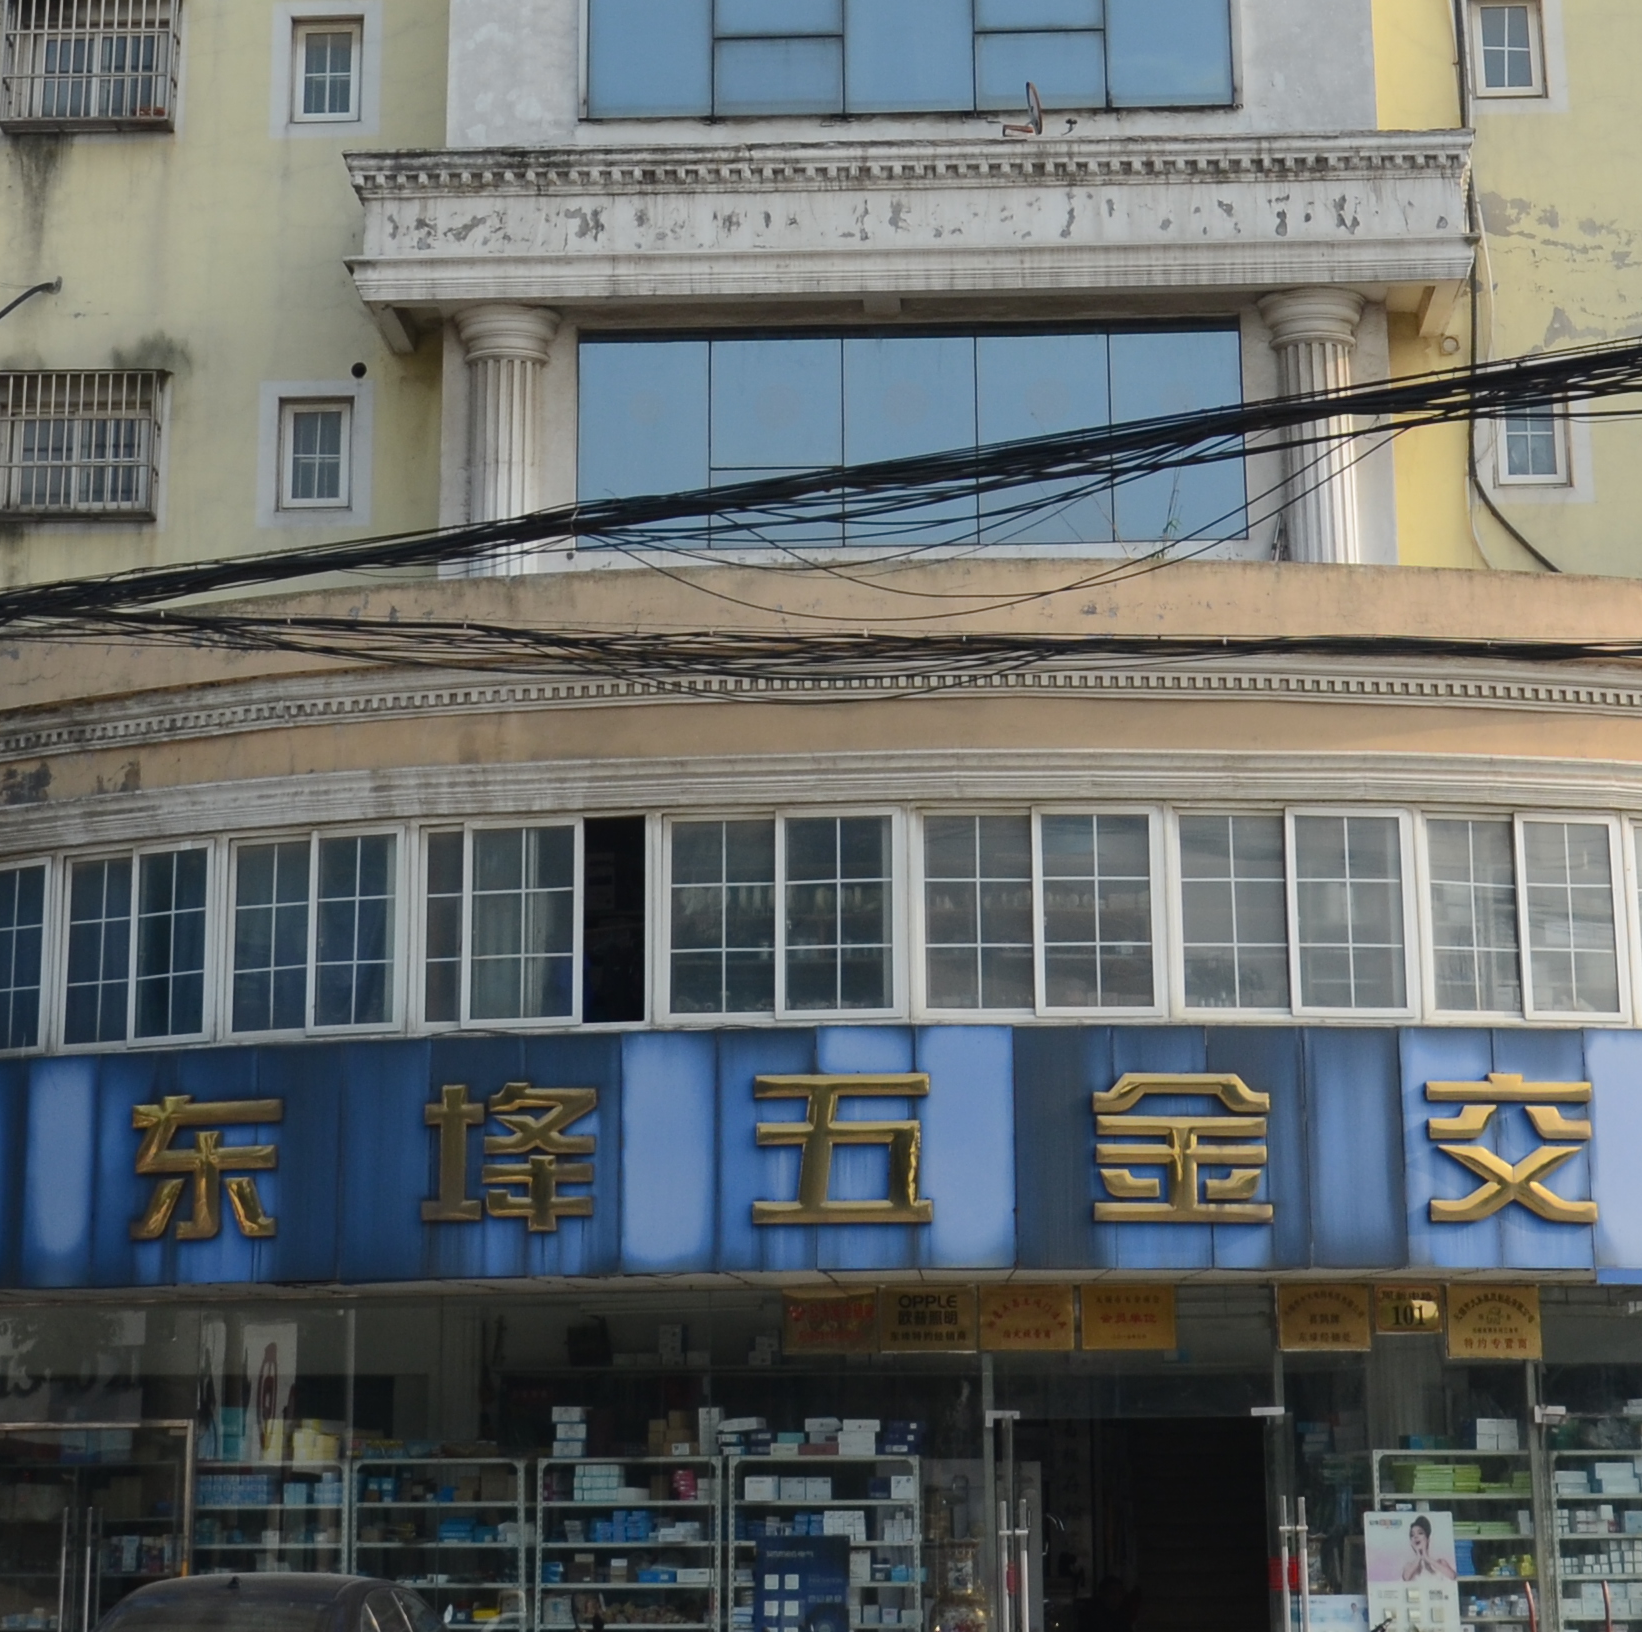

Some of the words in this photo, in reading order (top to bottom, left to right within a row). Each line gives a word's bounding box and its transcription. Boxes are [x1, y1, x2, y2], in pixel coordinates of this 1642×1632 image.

[898, 1294, 958, 1309] OPPLE
[898, 1310, 958, 1326] 欧普照明
[1392, 1304, 1426, 1326] 101
